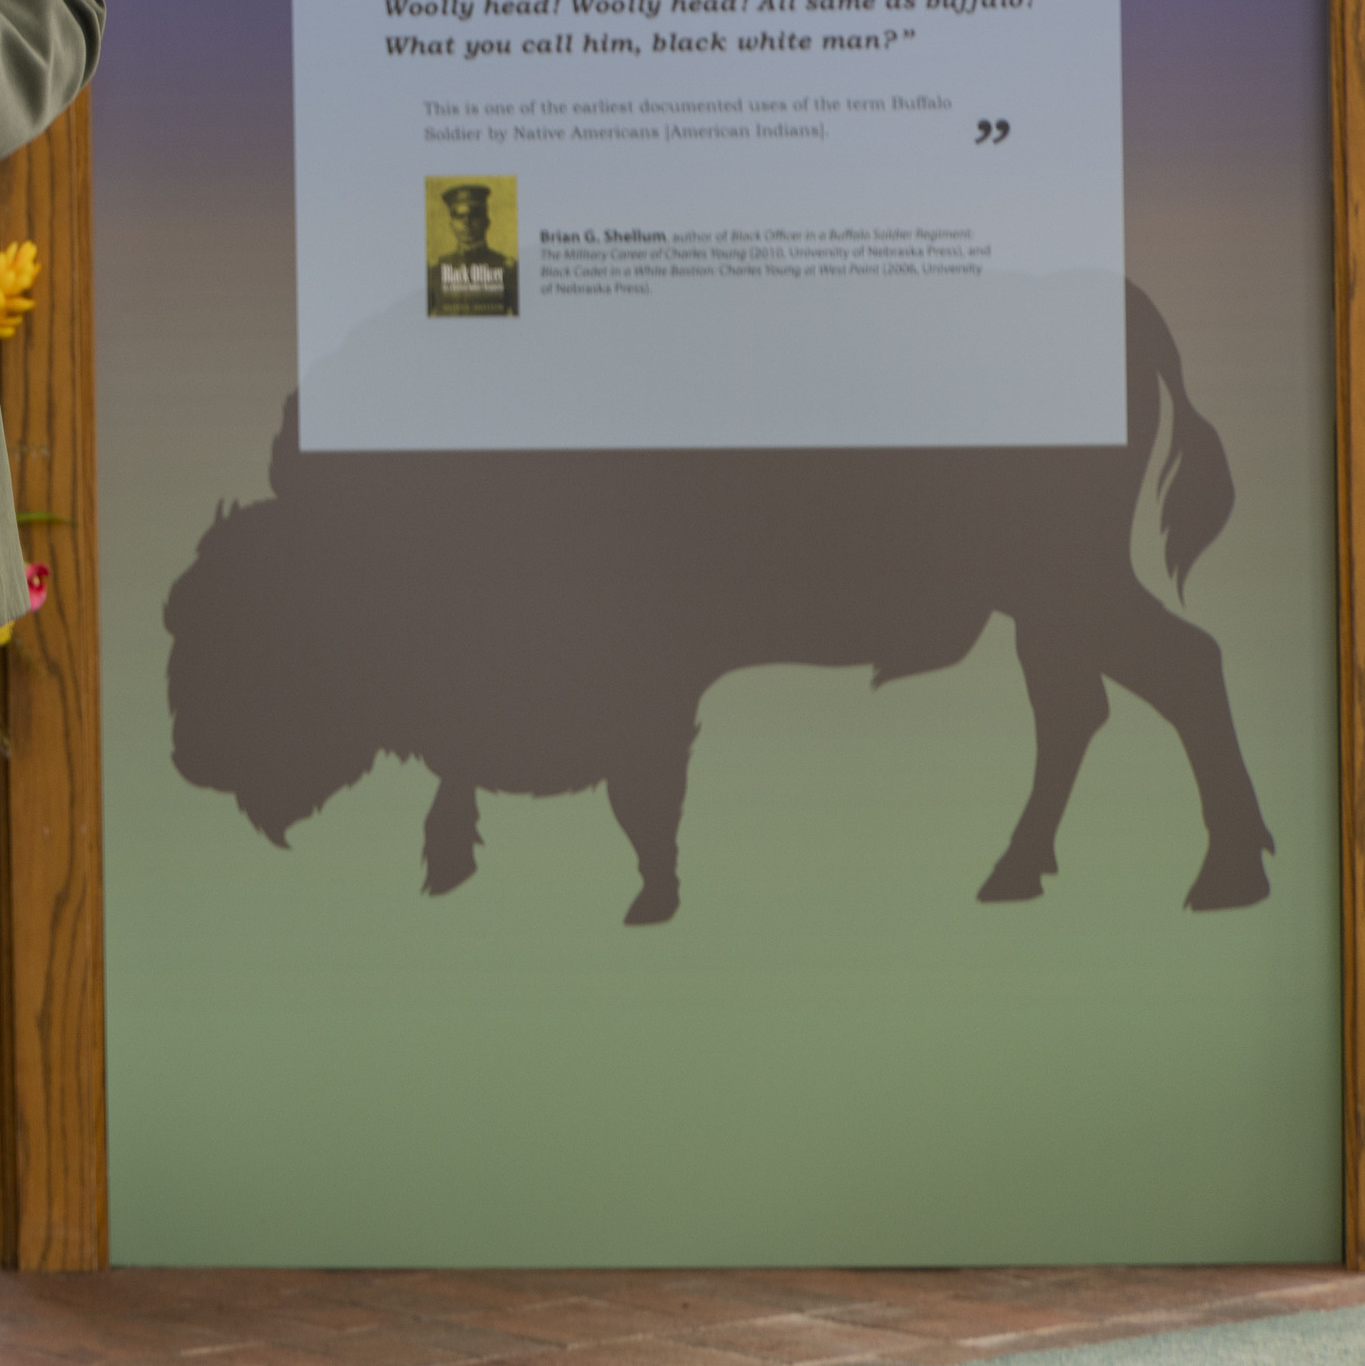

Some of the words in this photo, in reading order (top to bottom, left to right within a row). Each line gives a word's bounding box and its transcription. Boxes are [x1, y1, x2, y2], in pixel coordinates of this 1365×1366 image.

[386, 35, 455, 55] What
[464, 40, 511, 60] you
[522, 34, 573, 54] call
[583, 34, 642, 56] him,
[652, 32, 726, 52] black
[738, 31, 812, 51] white
[423, 101, 460, 116] This
[465, 102, 479, 115] is
[484, 104, 514, 115] one
[519, 100, 536, 115] of
[540, 100, 567, 115] the
[572, 99, 633, 114] earliest
[638, 98, 743, 113] documented
[748, 100, 787, 112] uses
[792, 96, 809, 112] of
[814, 96, 840, 112] the
[846, 98, 885, 110] term
[891, 95, 952, 111] Buffalo
[424, 126, 481, 141] Soldier
[488, 127, 507, 144] by
[513, 125, 565, 140] Native
[570, 126, 659, 140] Americans
[539, 230, 580, 245] Brian
[583, 229, 600, 243] G.
